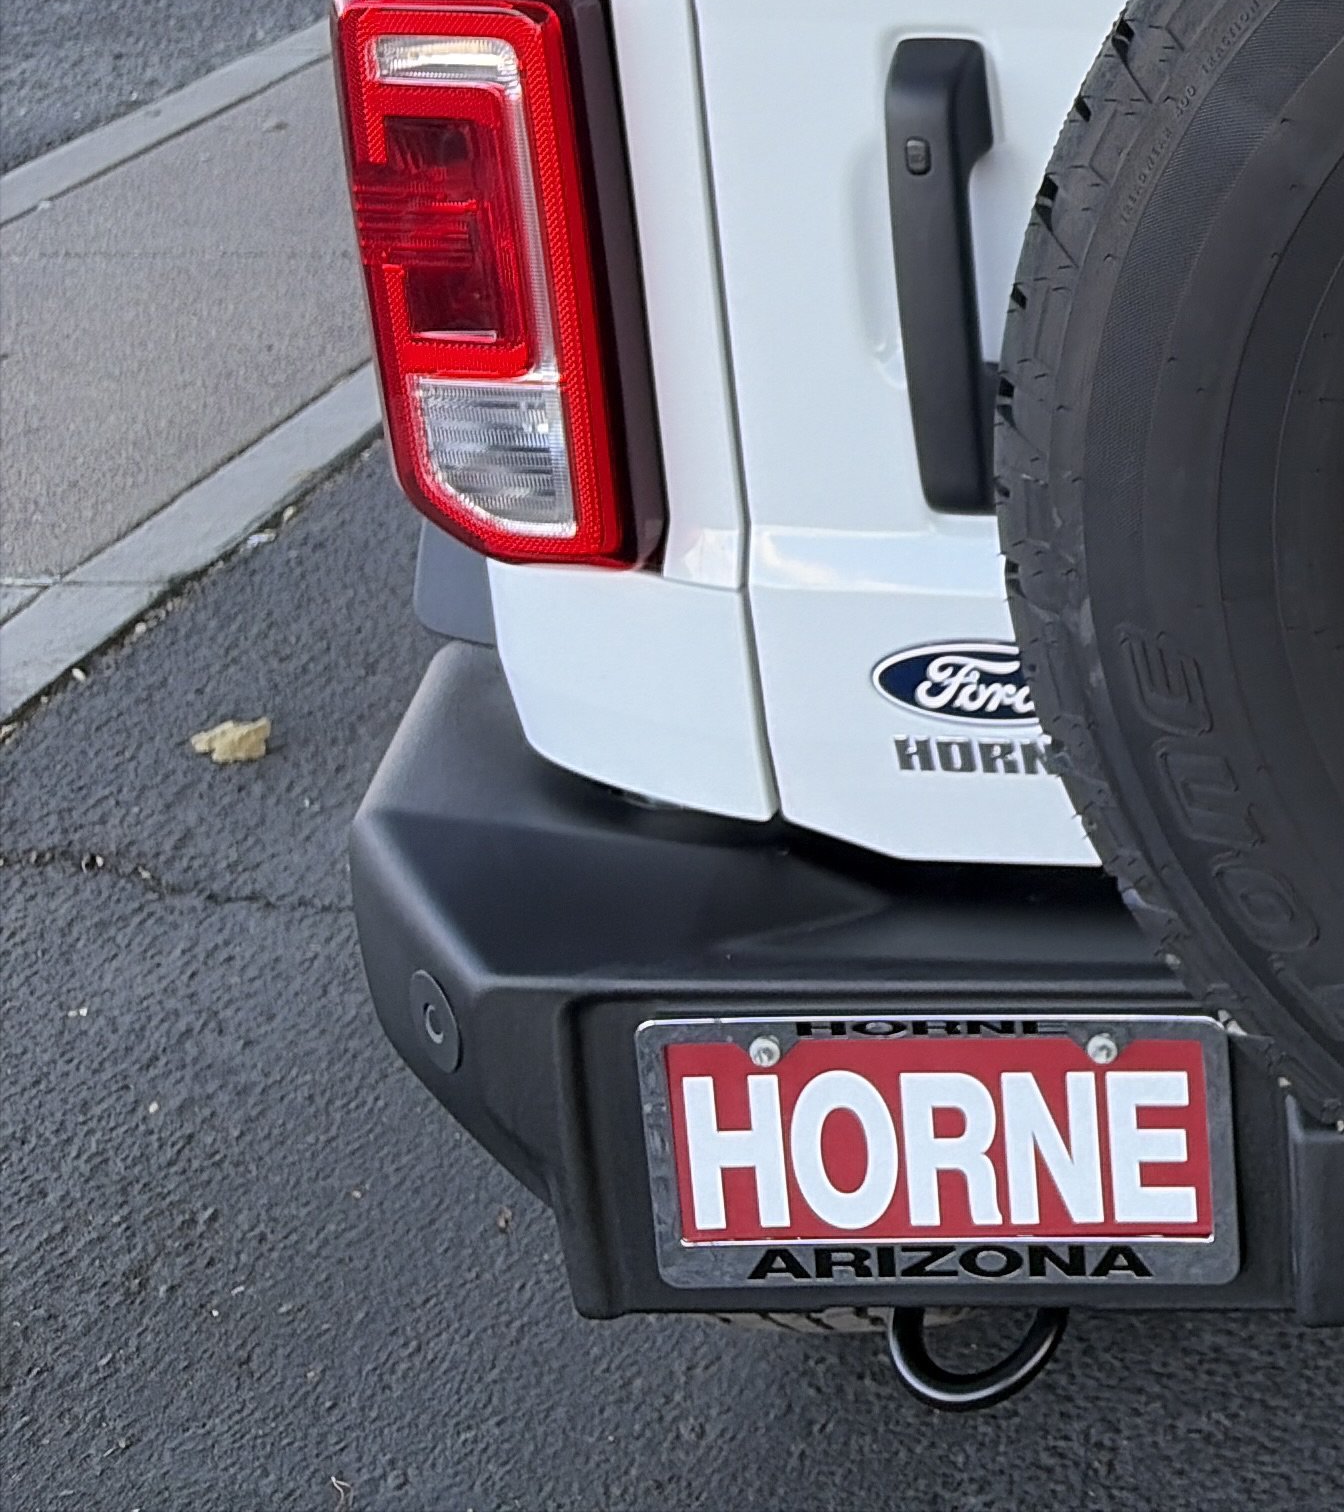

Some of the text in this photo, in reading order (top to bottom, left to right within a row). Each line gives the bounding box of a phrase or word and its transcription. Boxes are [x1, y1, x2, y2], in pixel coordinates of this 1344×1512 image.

[894, 738, 1060, 775] HORN
[796, 1021, 1067, 1037] HORNE
[682, 1069, 1198, 1230] HORNE
[747, 1244, 1155, 1281] ARIZONA
